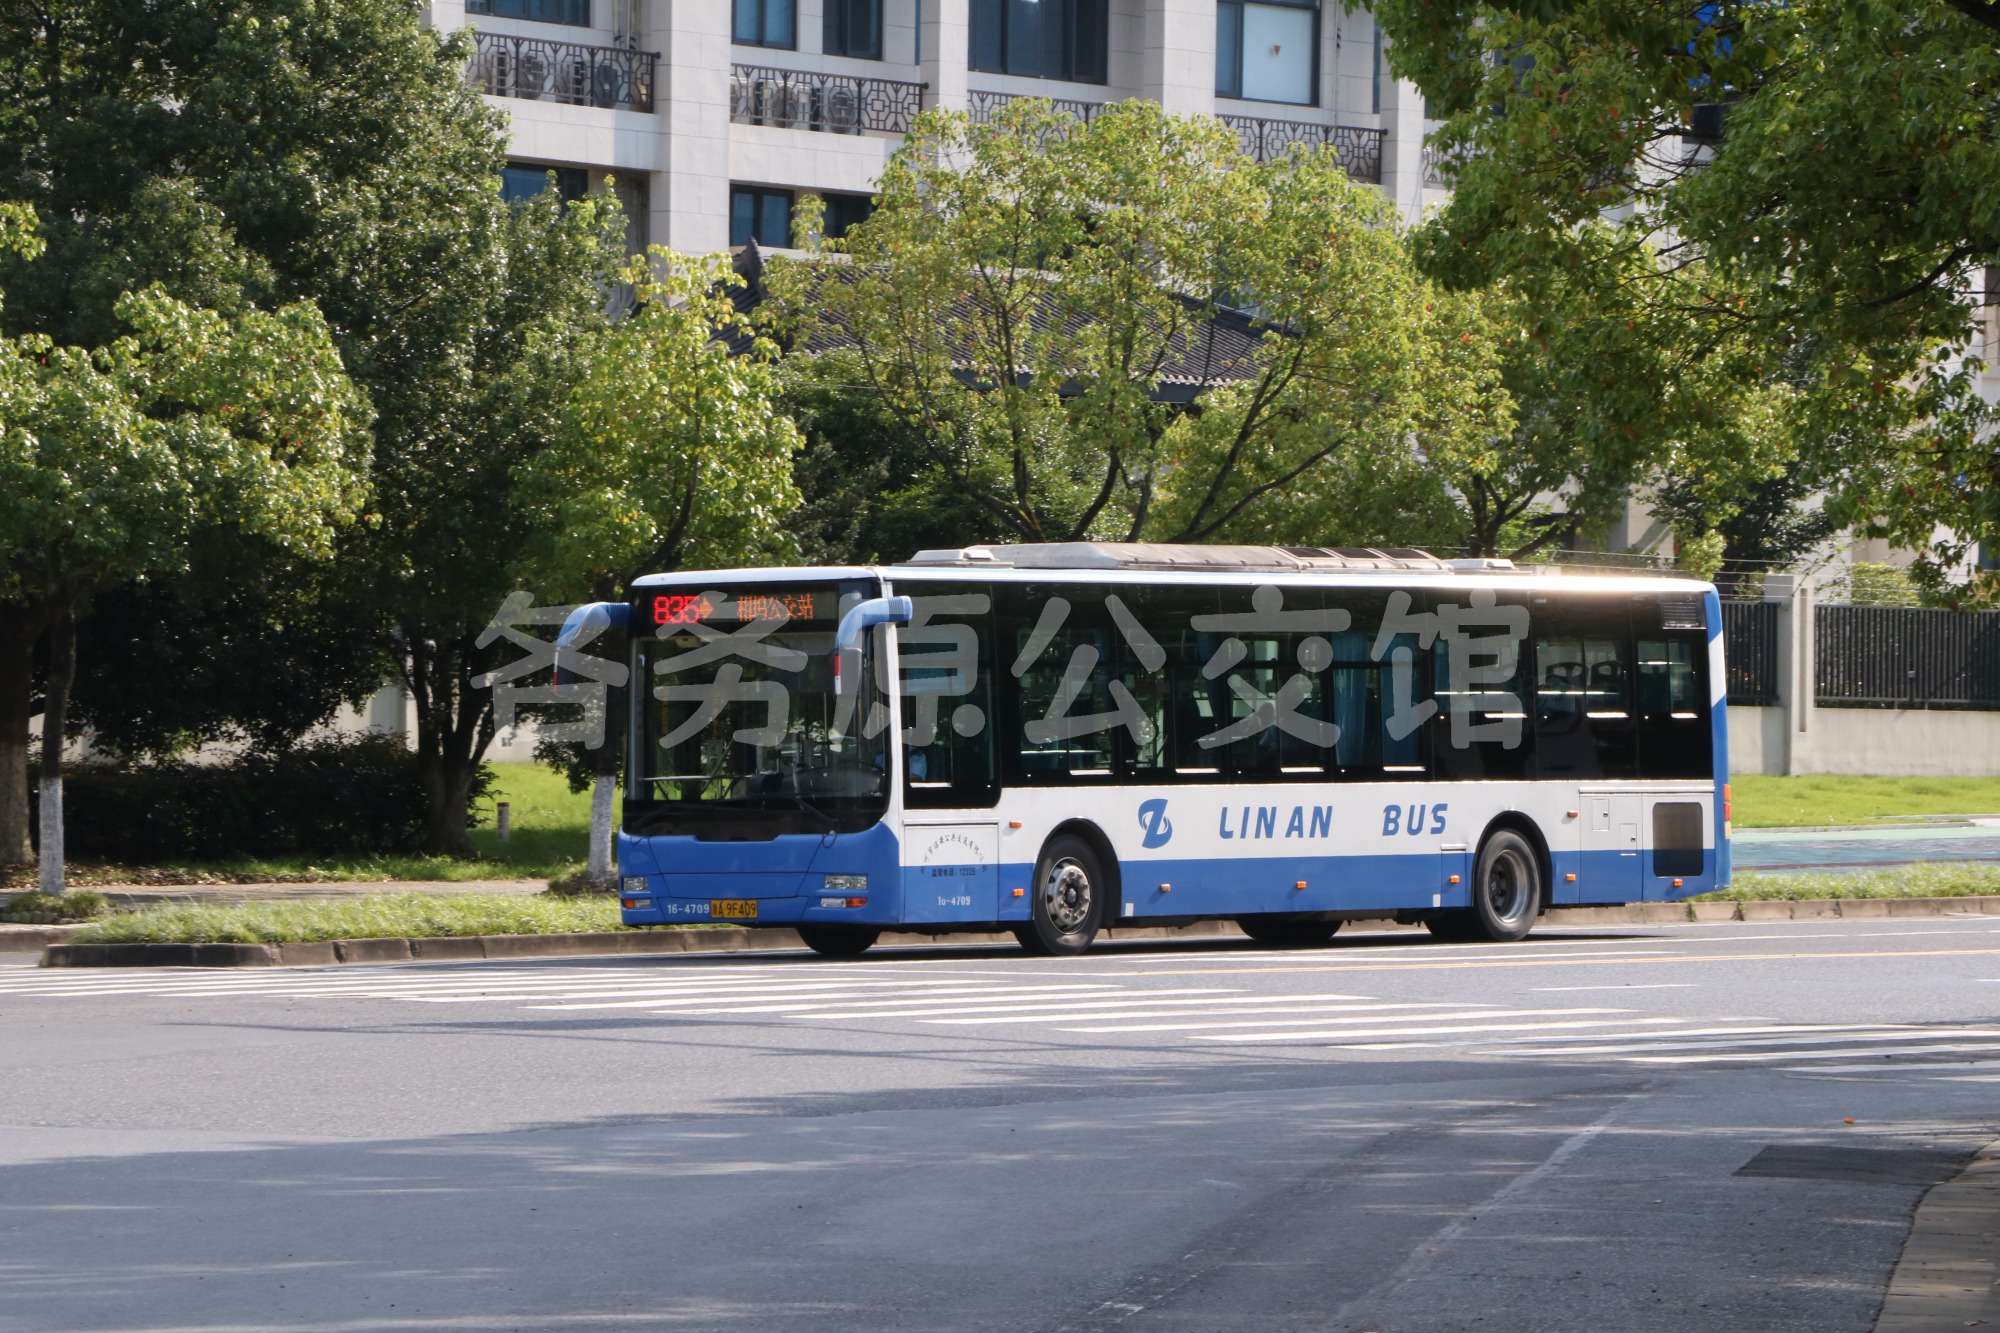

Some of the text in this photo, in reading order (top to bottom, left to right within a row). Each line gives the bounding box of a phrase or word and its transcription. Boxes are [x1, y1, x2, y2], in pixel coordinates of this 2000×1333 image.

[653, 595, 701, 625] 835
[1219, 803, 1448, 839] LINAN BUS
[667, 903, 710, 914] 16-4709
